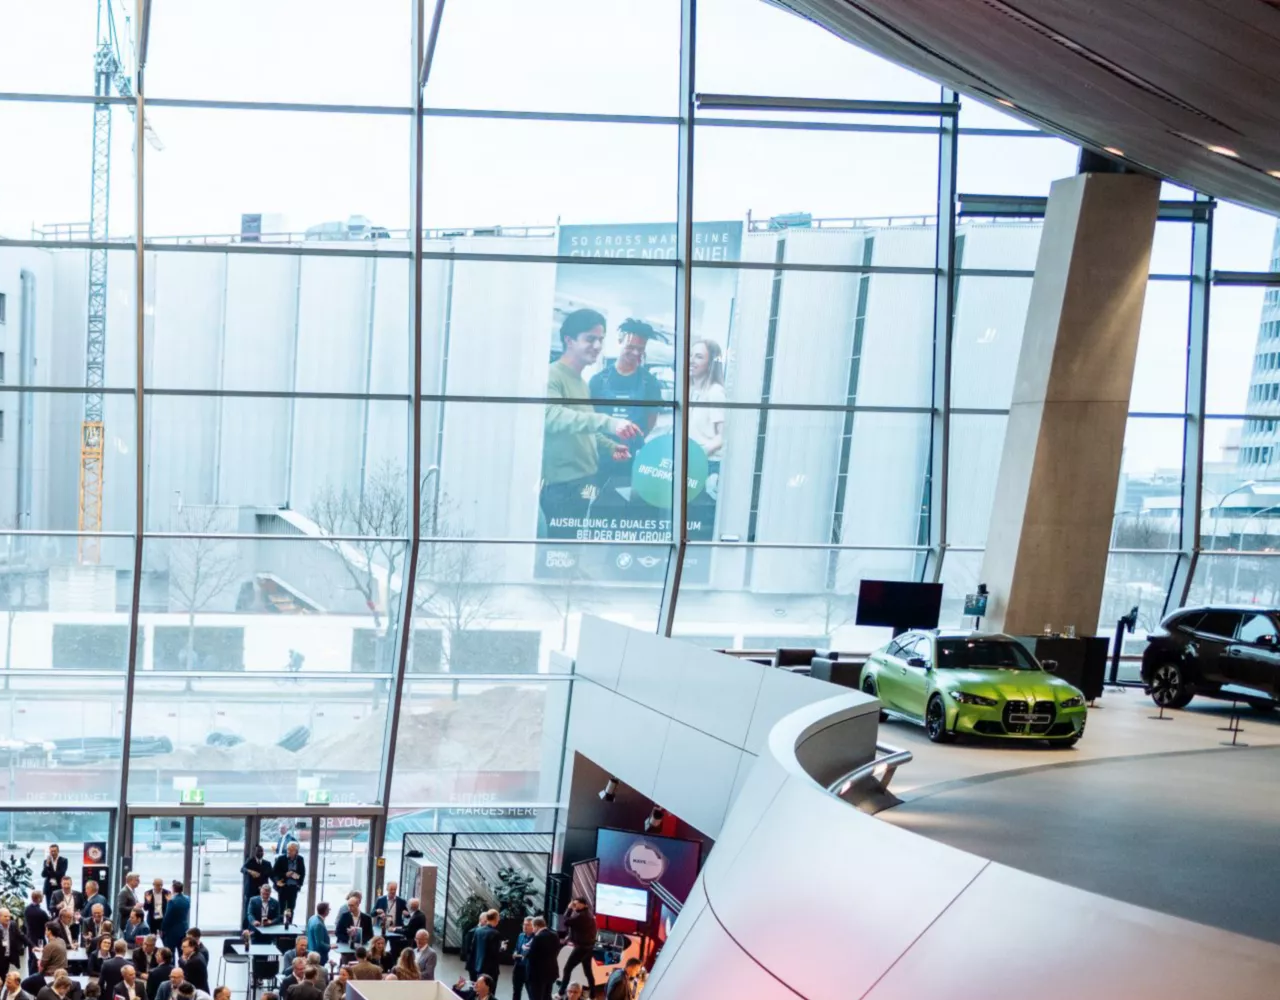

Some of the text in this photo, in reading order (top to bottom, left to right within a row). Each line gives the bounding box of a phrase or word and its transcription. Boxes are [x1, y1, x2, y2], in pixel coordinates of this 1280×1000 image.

[571, 232, 729, 246] SO GROSS WAR EINE
[642, 247, 677, 260] NOC
[694, 246, 728, 262] NIE!
[550, 517, 701, 530] AUSBILDUNG & DUALES STUM
[576, 529, 672, 542] BEI DER BMW GROUP
